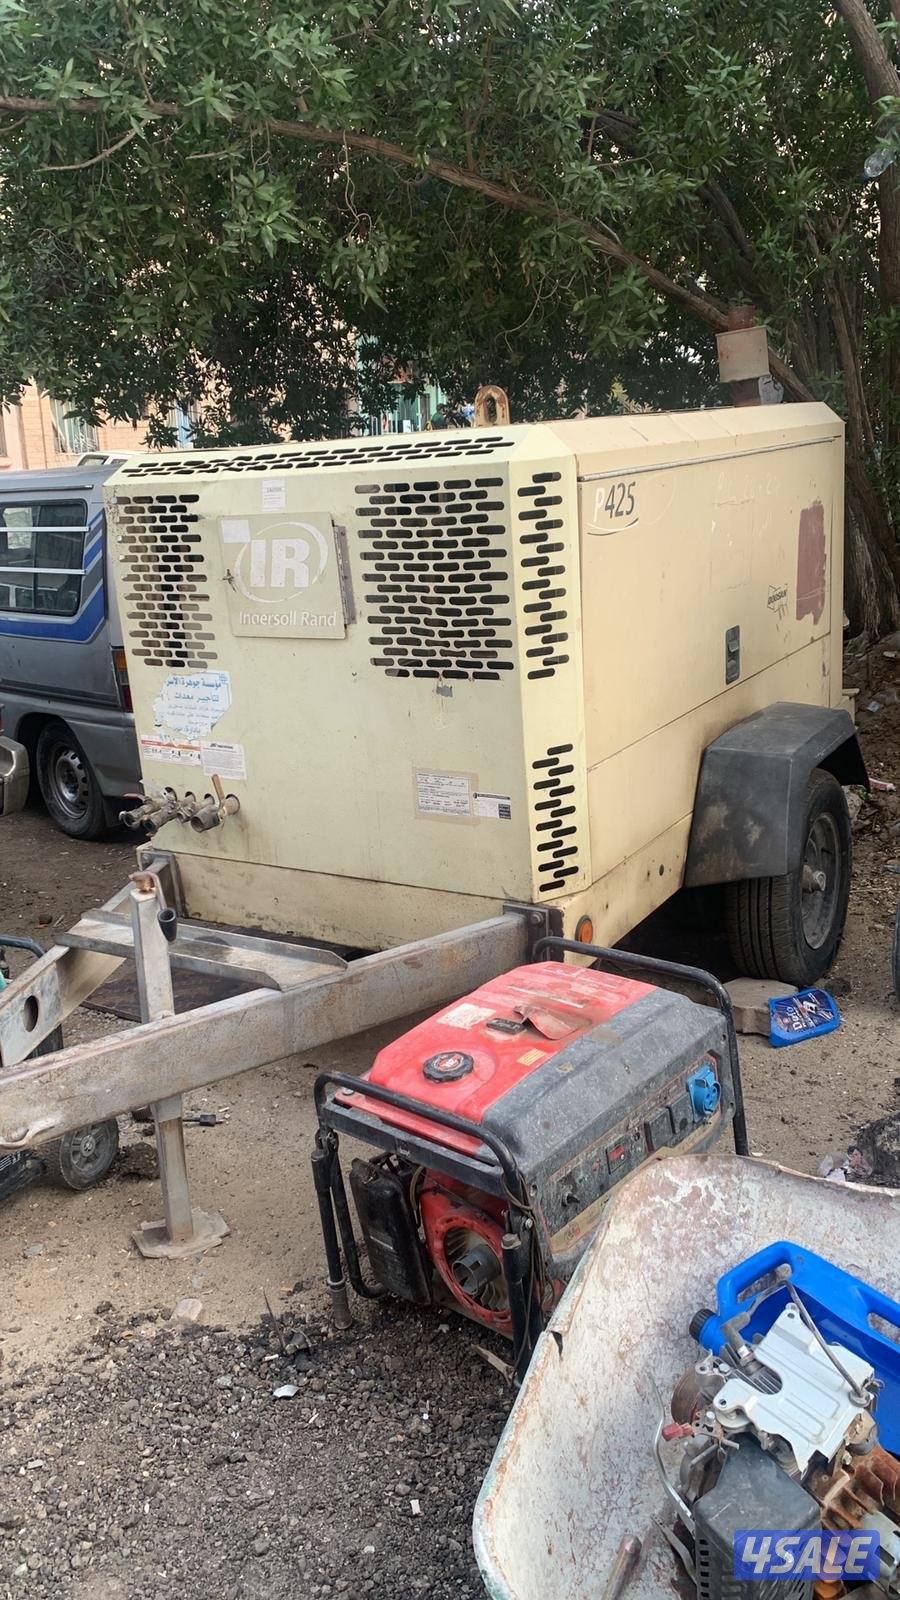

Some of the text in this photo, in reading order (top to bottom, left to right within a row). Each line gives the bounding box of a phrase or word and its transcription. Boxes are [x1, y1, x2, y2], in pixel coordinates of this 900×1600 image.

[593, 481, 636, 522] P425
[250, 538, 310, 588] IR
[239, 610, 337, 627] Ingersoll Rand
